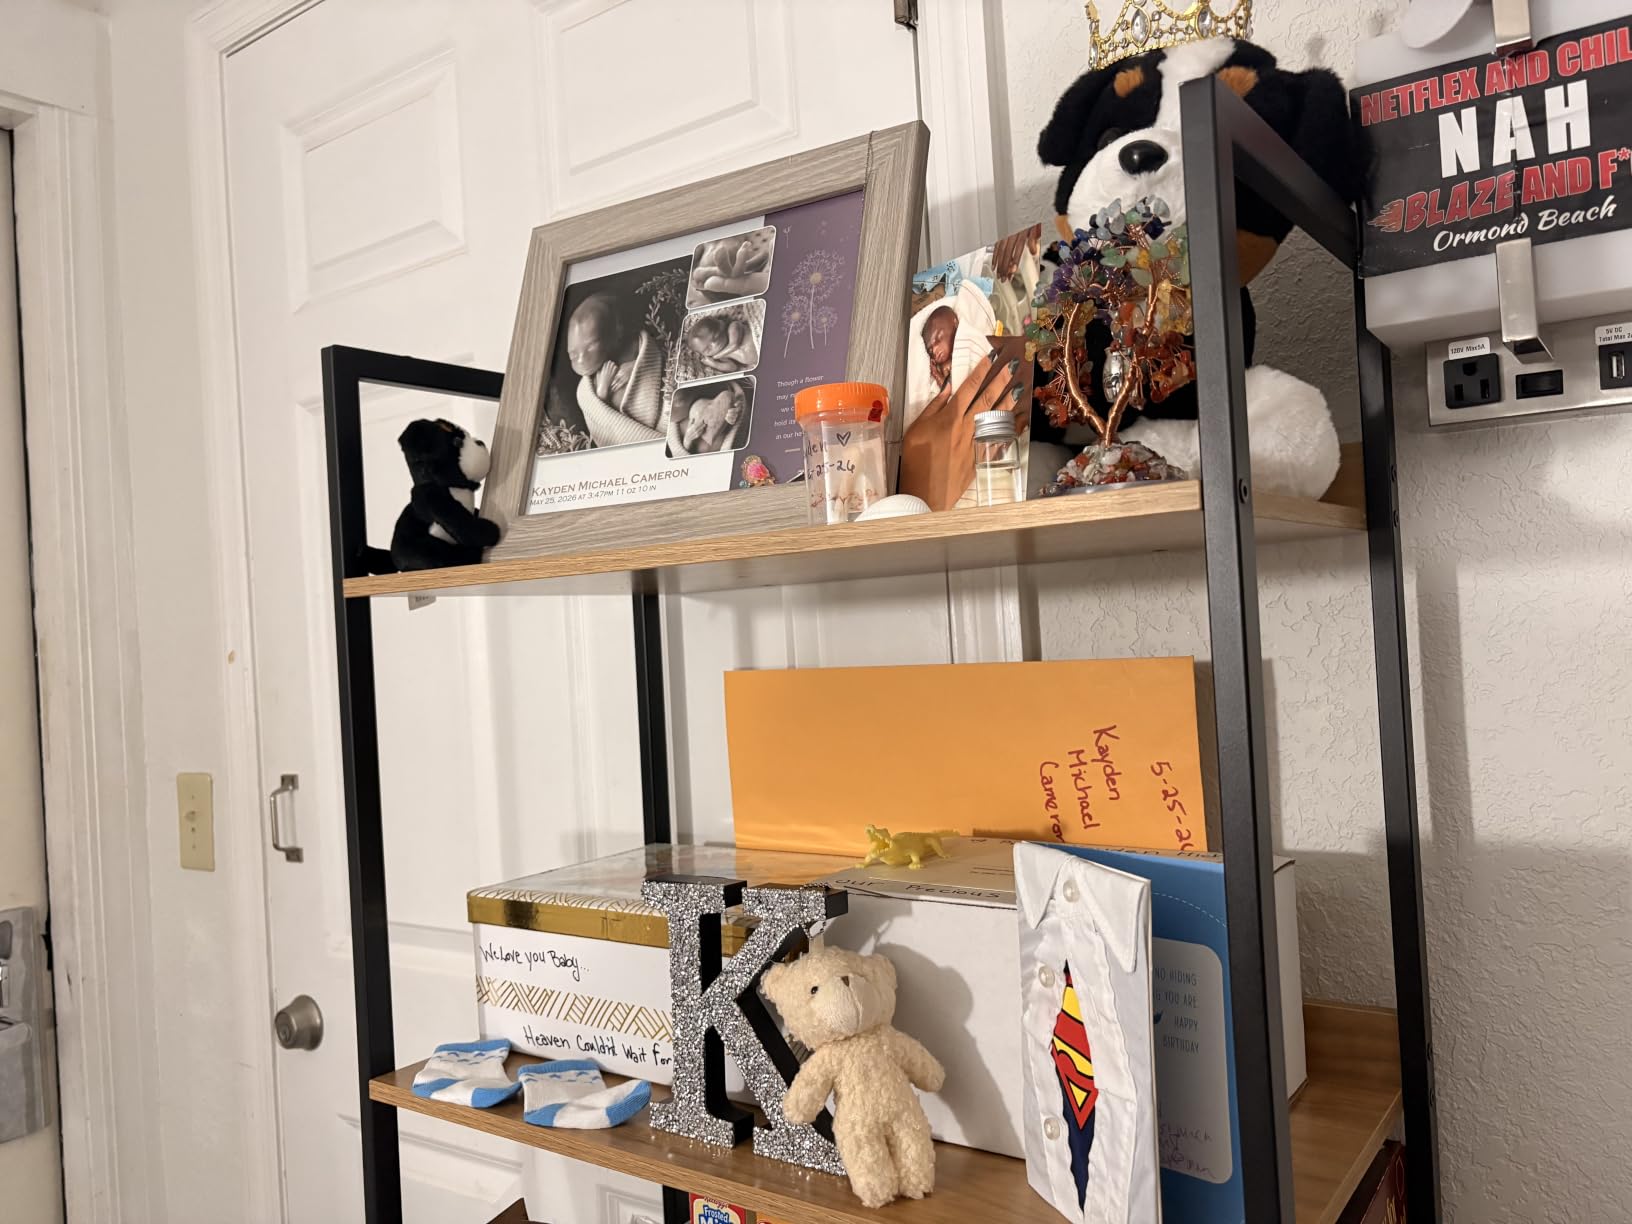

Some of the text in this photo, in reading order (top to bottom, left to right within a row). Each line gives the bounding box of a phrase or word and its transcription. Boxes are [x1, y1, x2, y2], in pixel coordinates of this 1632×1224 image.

[1361, 66, 1480, 126] NETFLEX
[1485, 50, 1550, 96] AND
[1438, 79, 1591, 178] NAH
[1403, 170, 1515, 233] BLAZE
[1521, 156, 1593, 205] AND
[1433, 195, 1617, 252] Ormond Beach
[776, 379, 799, 388] Though
[805, 375, 824, 383] flower
[531, 484, 576, 497] KAYDEN
[631, 468, 689, 484] CAMERON
[557, 494, 577, 503] 2026
[1067, 749, 1101, 830] Michael
[1093, 724, 1122, 801] Kayden
[479, 943, 499, 963] We
[525, 950, 546, 972] you
[522, 1025, 571, 1050] Heaven
[621, 1043, 647, 1064] Wait
[641, 879, 849, 1178] K
[703, 1206, 729, 1223] Frosted
